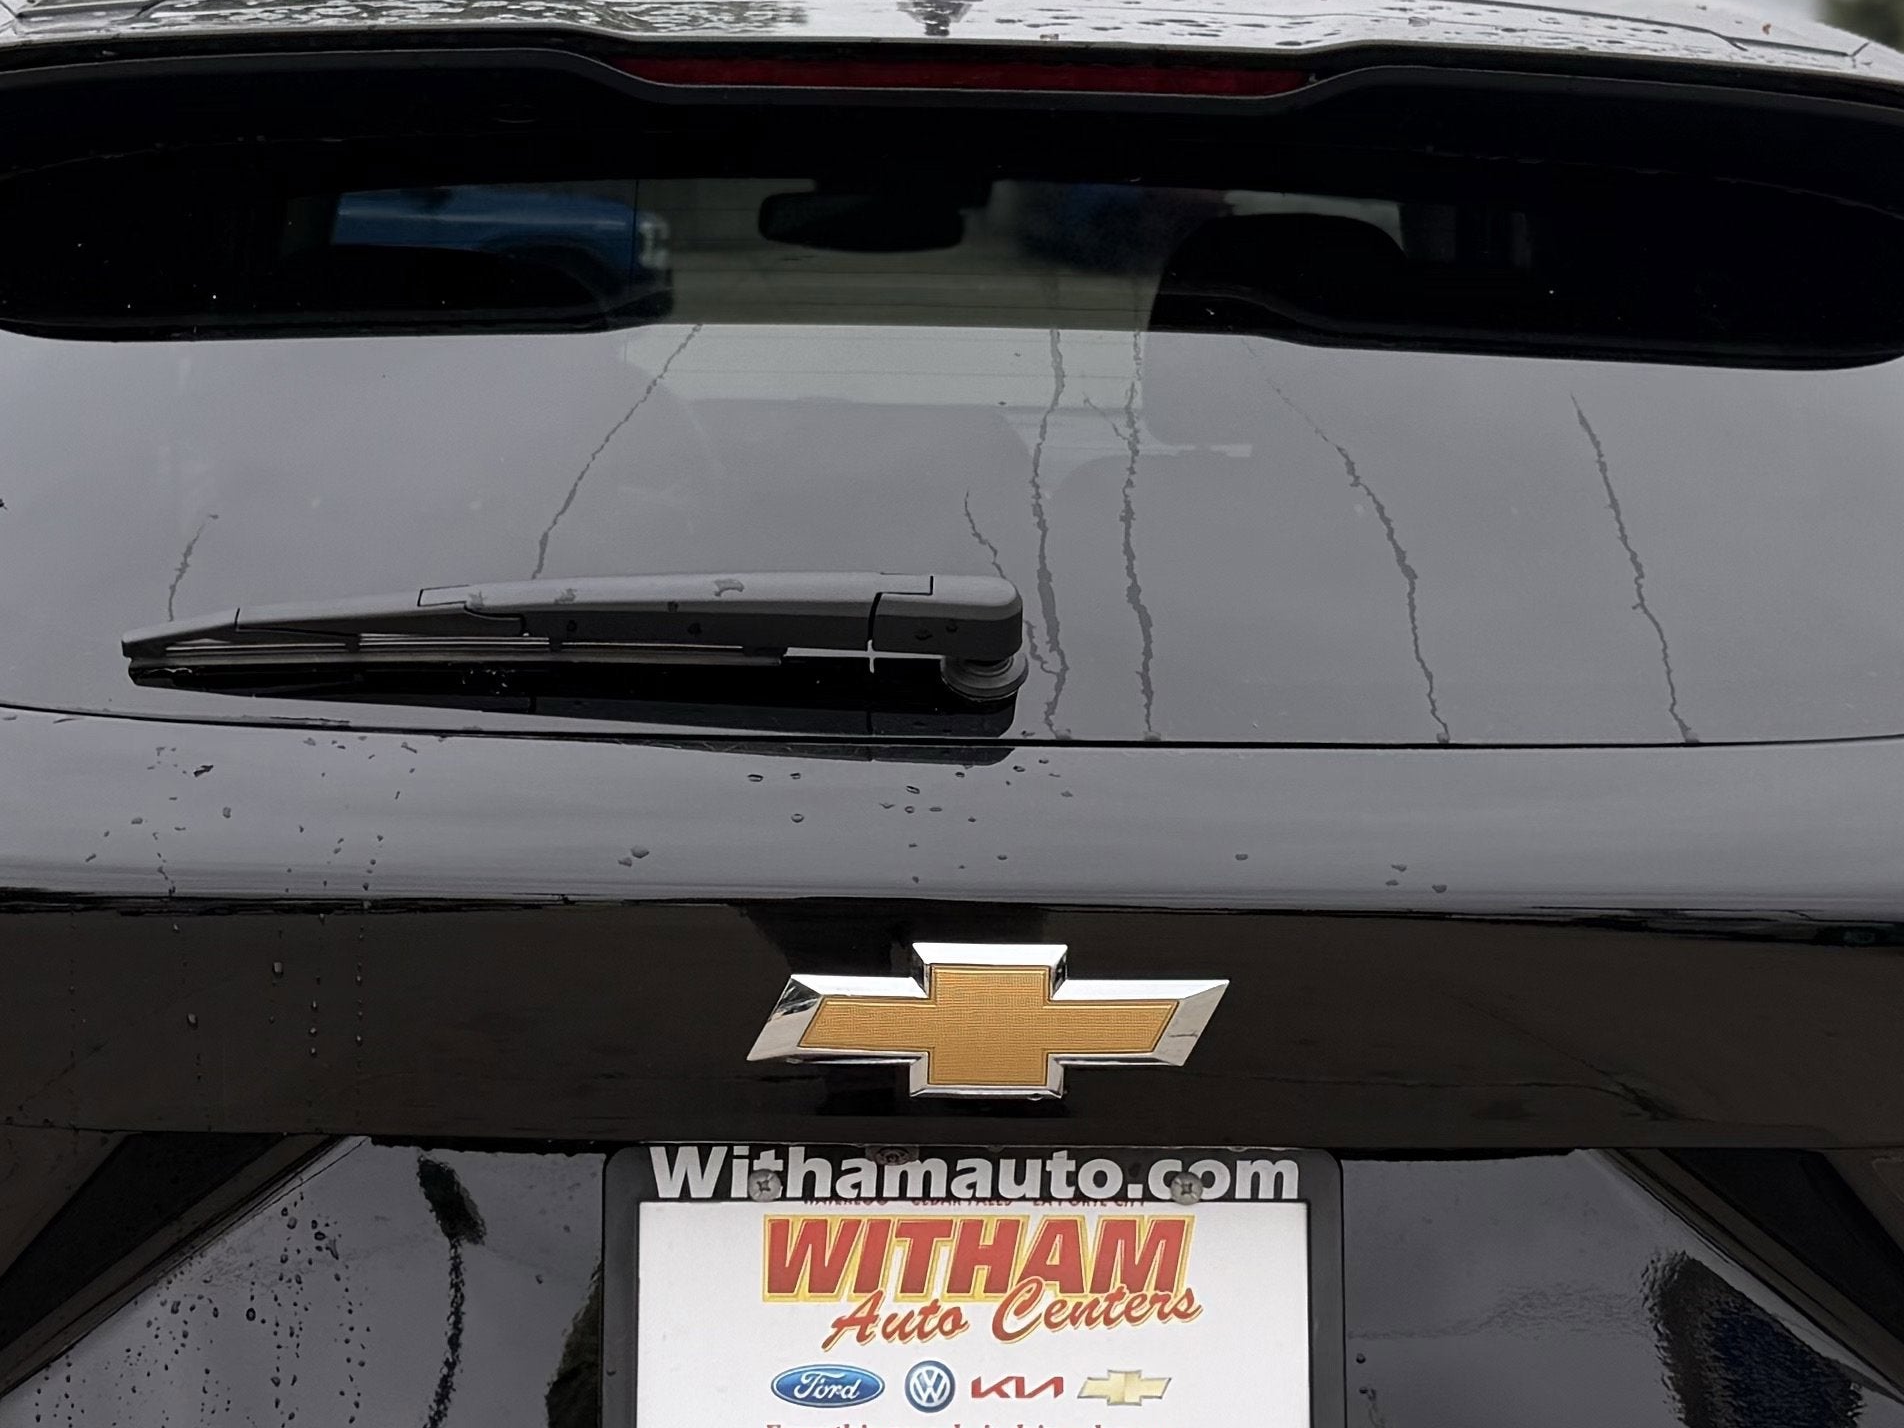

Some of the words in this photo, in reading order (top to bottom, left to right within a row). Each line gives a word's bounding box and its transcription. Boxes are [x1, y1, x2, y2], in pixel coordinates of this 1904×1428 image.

[764, 1215, 1195, 1300] WITHAM
[821, 1289, 970, 1352] Auto
[992, 1276, 1203, 1344] Centers
[793, 1370, 863, 1401] Ford
